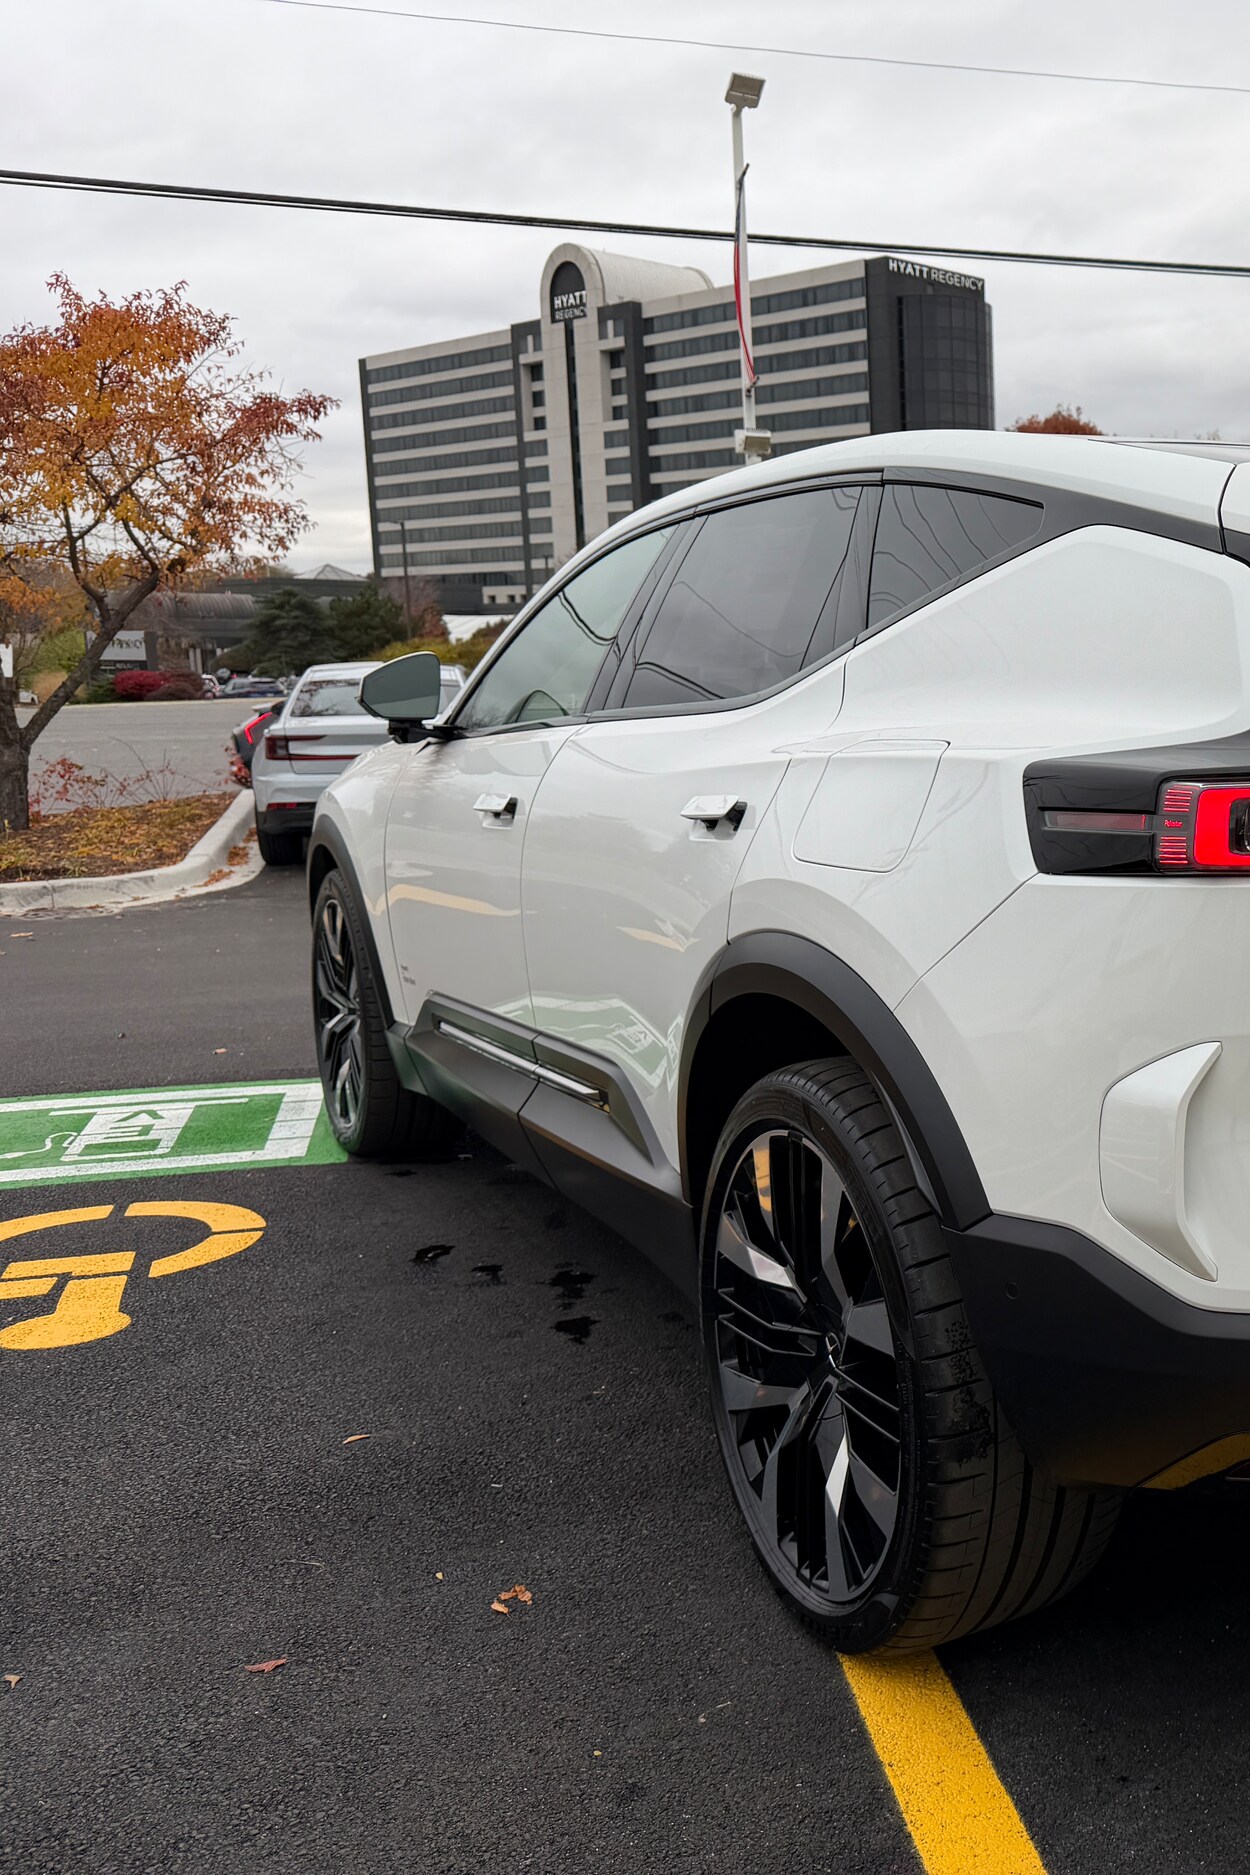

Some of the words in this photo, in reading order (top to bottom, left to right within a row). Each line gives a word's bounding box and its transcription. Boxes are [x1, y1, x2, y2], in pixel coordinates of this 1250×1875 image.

[889, 258, 929, 279] HYATT
[931, 268, 984, 291] REGENCY
[553, 290, 587, 309] HYATT
[555, 306, 587, 320] REGENC
